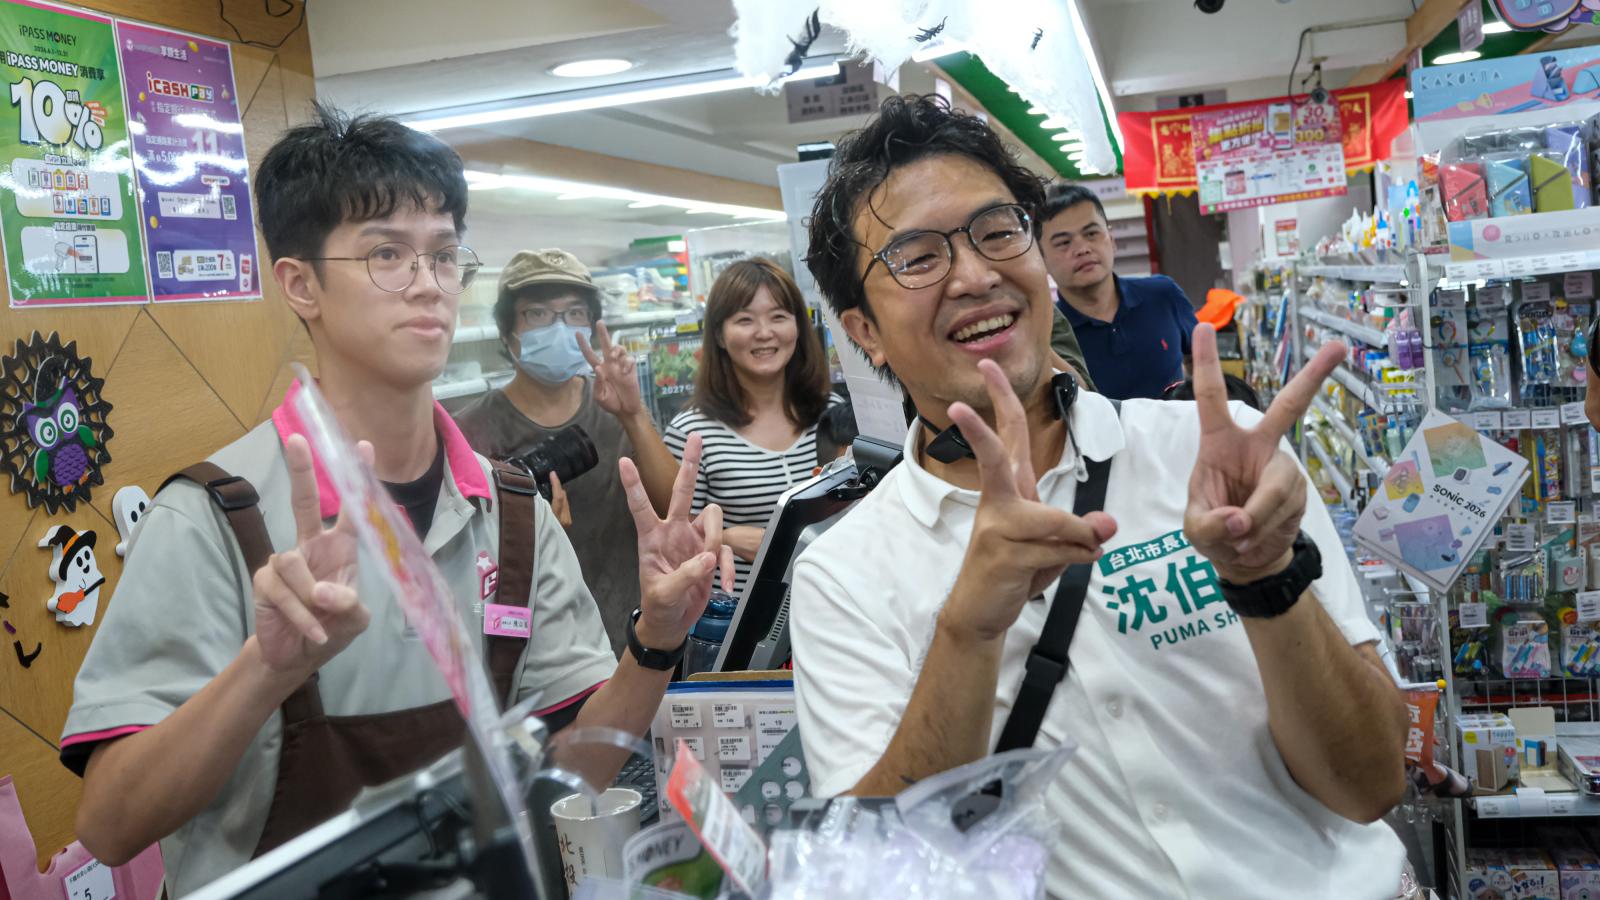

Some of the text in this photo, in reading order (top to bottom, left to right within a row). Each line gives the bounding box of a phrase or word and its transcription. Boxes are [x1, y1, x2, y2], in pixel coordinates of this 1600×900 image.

[19, 25, 77, 46] iPASS MONEY
[7, 51, 39, 70] iPASS
[40, 59, 79, 77] MONEY
[9, 76, 104, 150] 10%
[217, 254, 224, 271] 7
[1464, 501, 1487, 519] 2026
[1102, 555, 1227, 635] 沈伯
[1150, 610, 1239, 650] PUMA SH
[84, 887, 92, 900] 5
